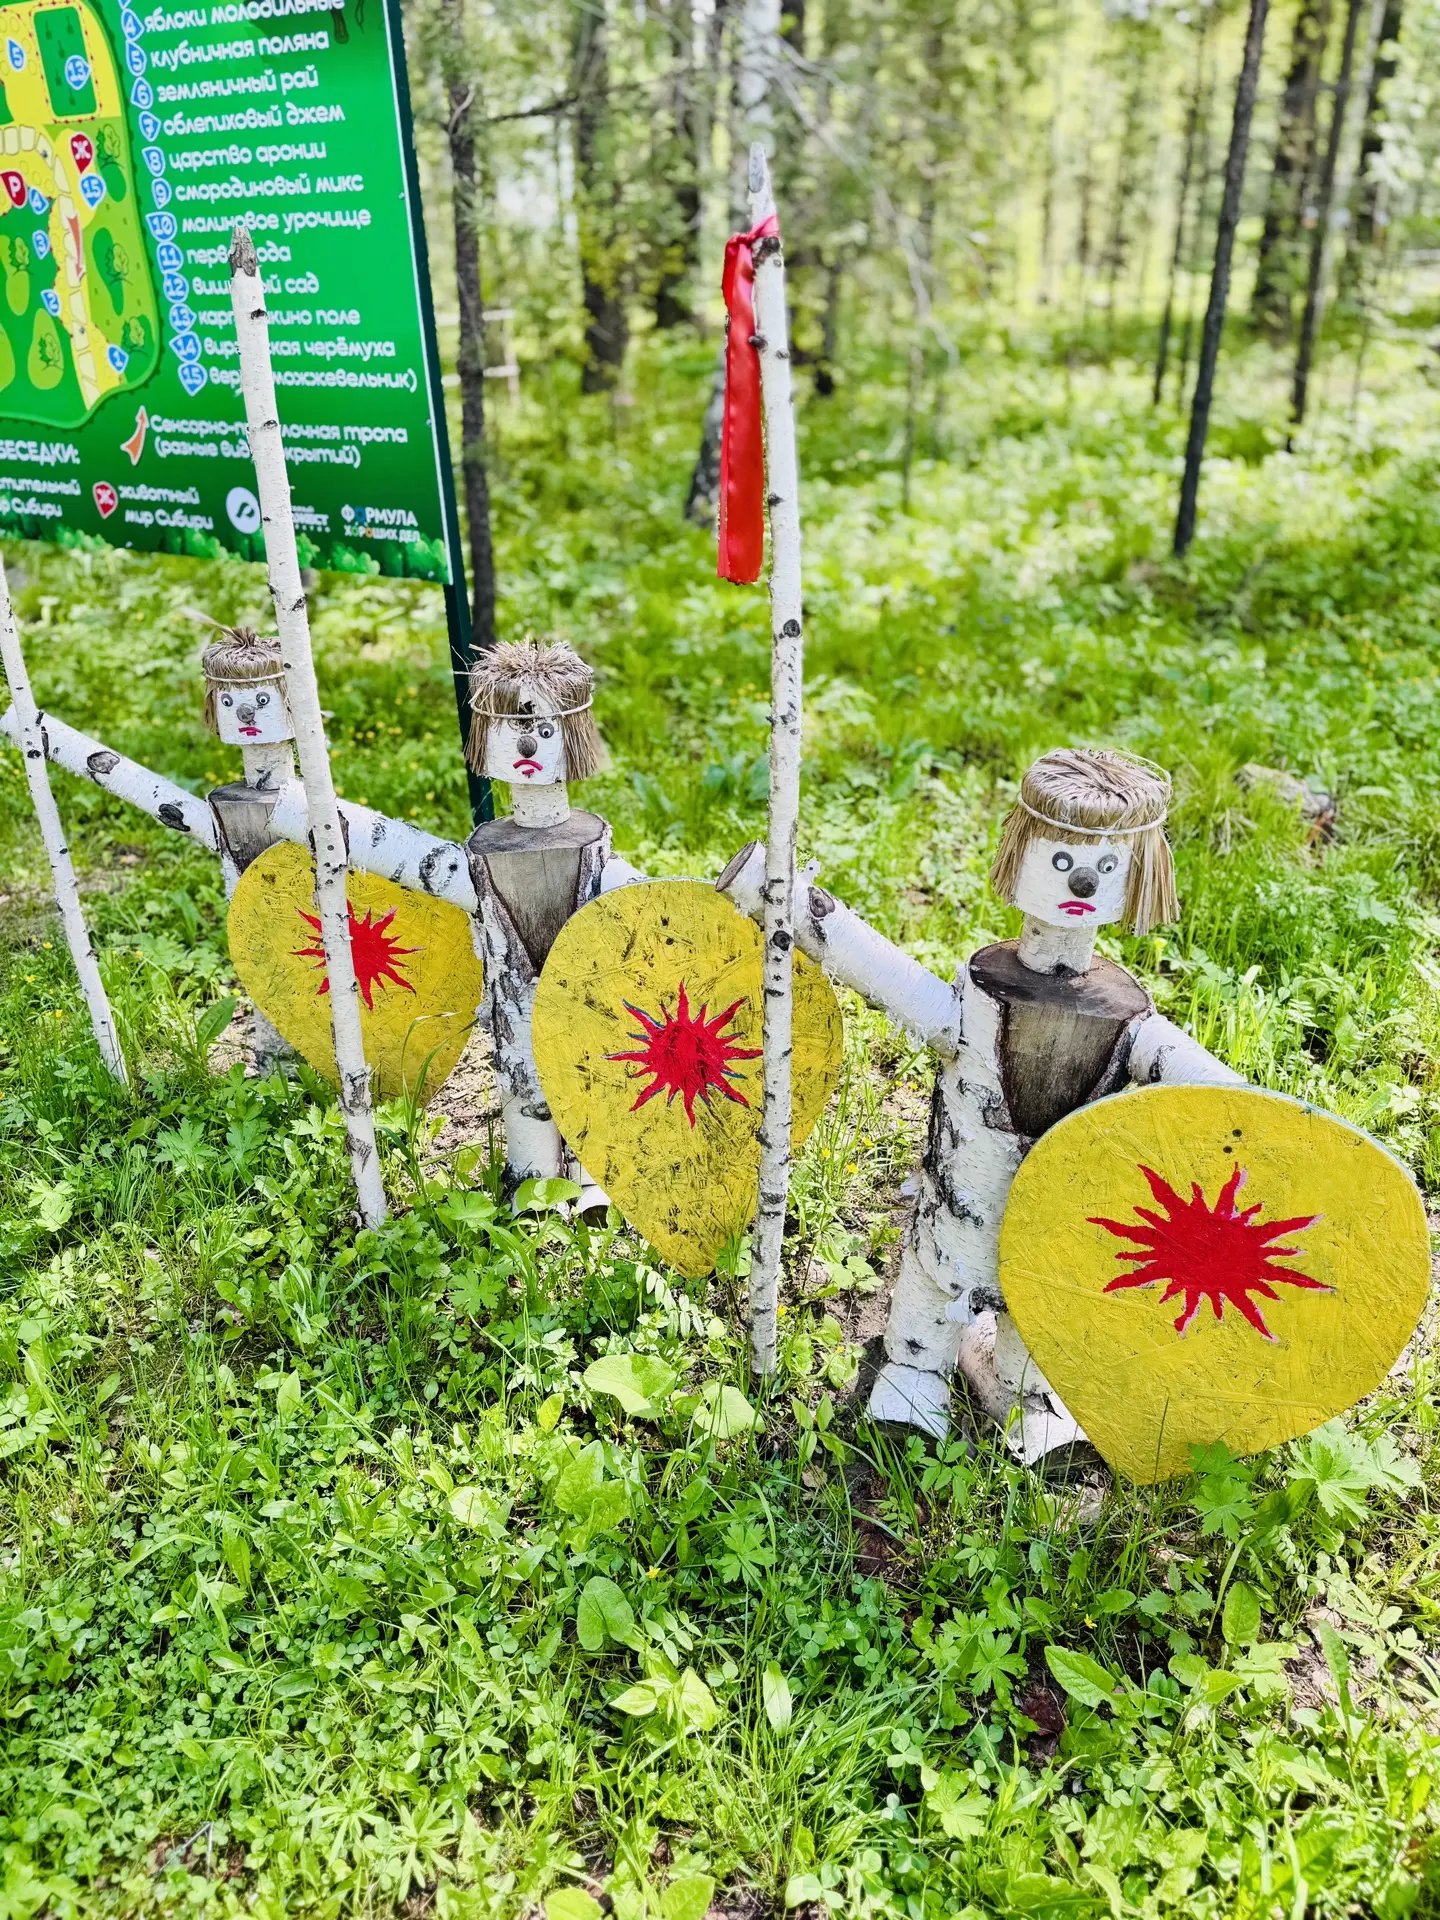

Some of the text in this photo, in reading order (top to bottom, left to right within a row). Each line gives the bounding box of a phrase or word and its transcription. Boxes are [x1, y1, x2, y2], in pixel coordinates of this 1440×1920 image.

[125, 17, 136, 35] 4
[144, 7, 207, 33] яблоки
[13, 48, 23, 65] 5
[132, 31, 330, 72] 5 клубничная поляна
[69, 62, 86, 83] 13
[138, 64, 319, 103] 6 земляничный рай
[142, 101, 346, 136] 7 облепиховый джем
[72, 140, 91, 159] Ж
[150, 142, 327, 172] 8 царство аронии
[83, 179, 101, 195] 15
[156, 173, 364, 204] 9 смородиновый микс
[32, 194, 42, 209] 4
[152, 209, 371, 235] 10 малиновое урочище
[160, 240, 292, 268] 11 первода
[167, 279, 185, 296] 12
[285, 272, 319, 294] сад
[172, 309, 190, 327] 13
[315, 309, 361, 325] поле
[115, 352, 123, 367] 1
[177, 339, 194, 356] 14
[305, 336, 395, 361] черёмуха
[182, 369, 201, 385] 15
[273, 368, 417, 393] можжевельник)
[150, 414, 408, 445] Сенсорно-плочная тропа
[154, 436, 361, 468] (разные вид крытий)
[118, 484, 200, 505] животный
[125, 508, 214, 530] мир Сибири
[341, 504, 419, 527] ФОРМУЛА
